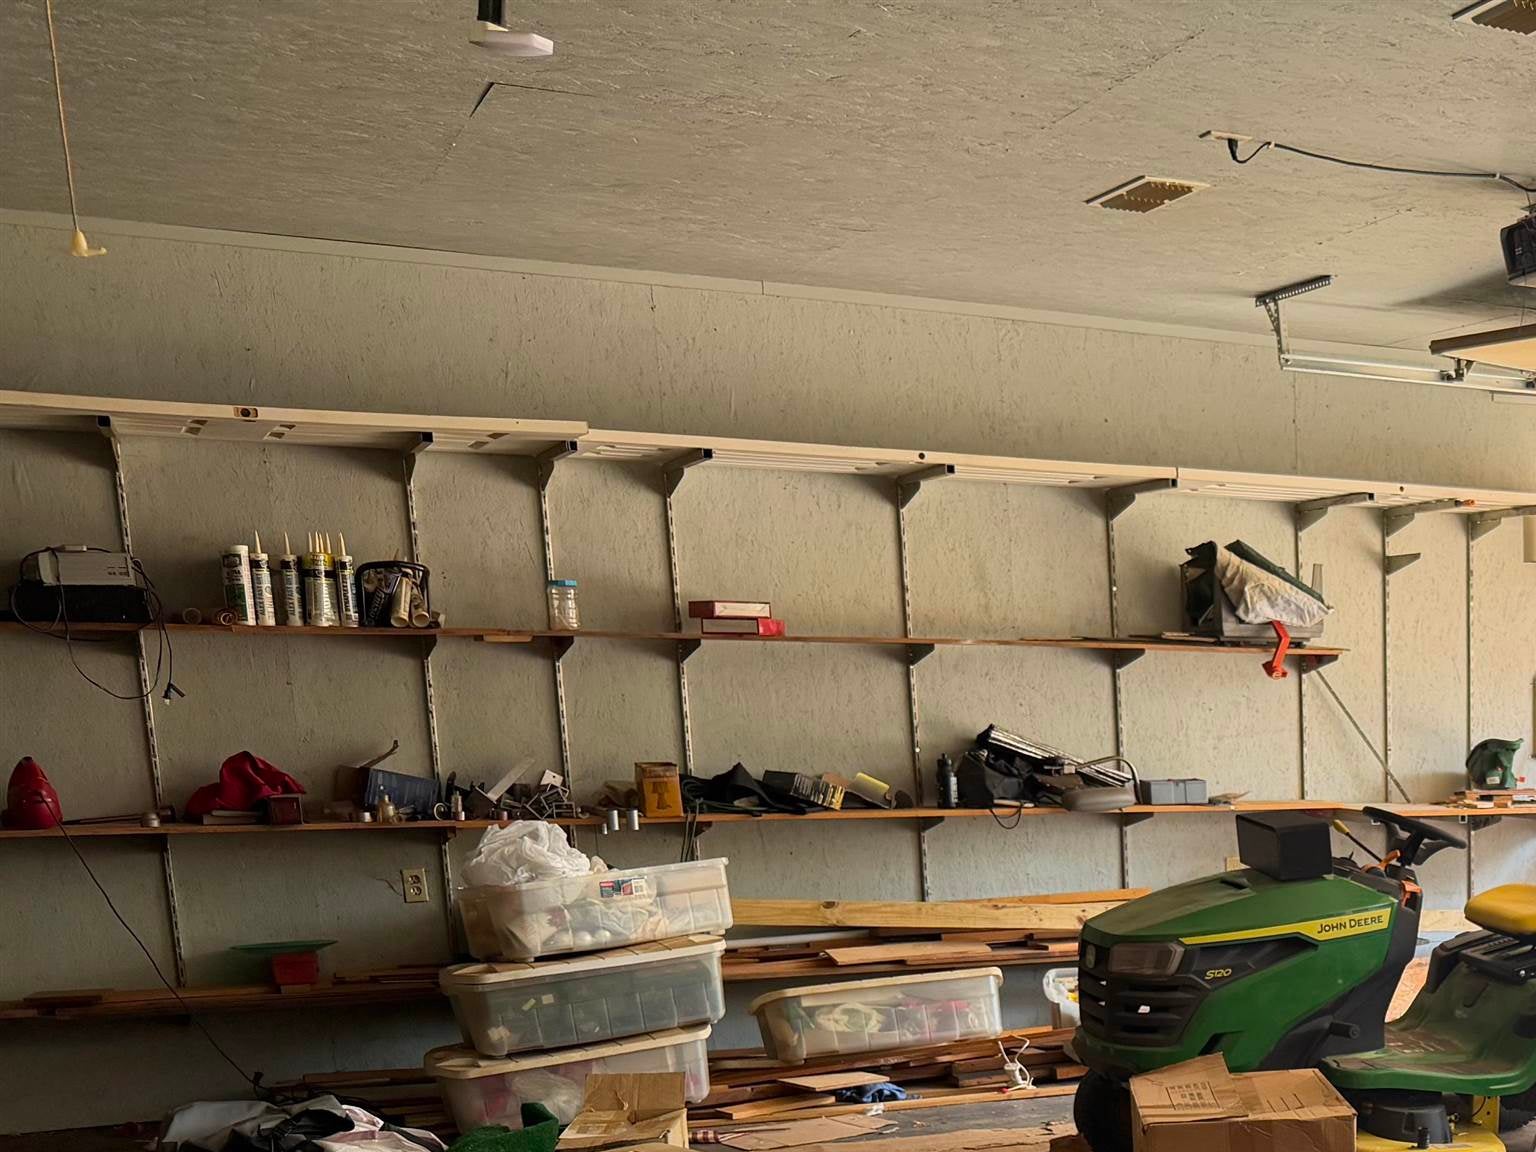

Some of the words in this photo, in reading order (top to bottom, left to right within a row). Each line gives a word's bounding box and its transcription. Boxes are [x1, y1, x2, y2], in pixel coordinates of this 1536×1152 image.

[1317, 921, 1347, 934] JOHN
[1348, 915, 1384, 929] DEERE
[1204, 968, 1233, 980] S120
